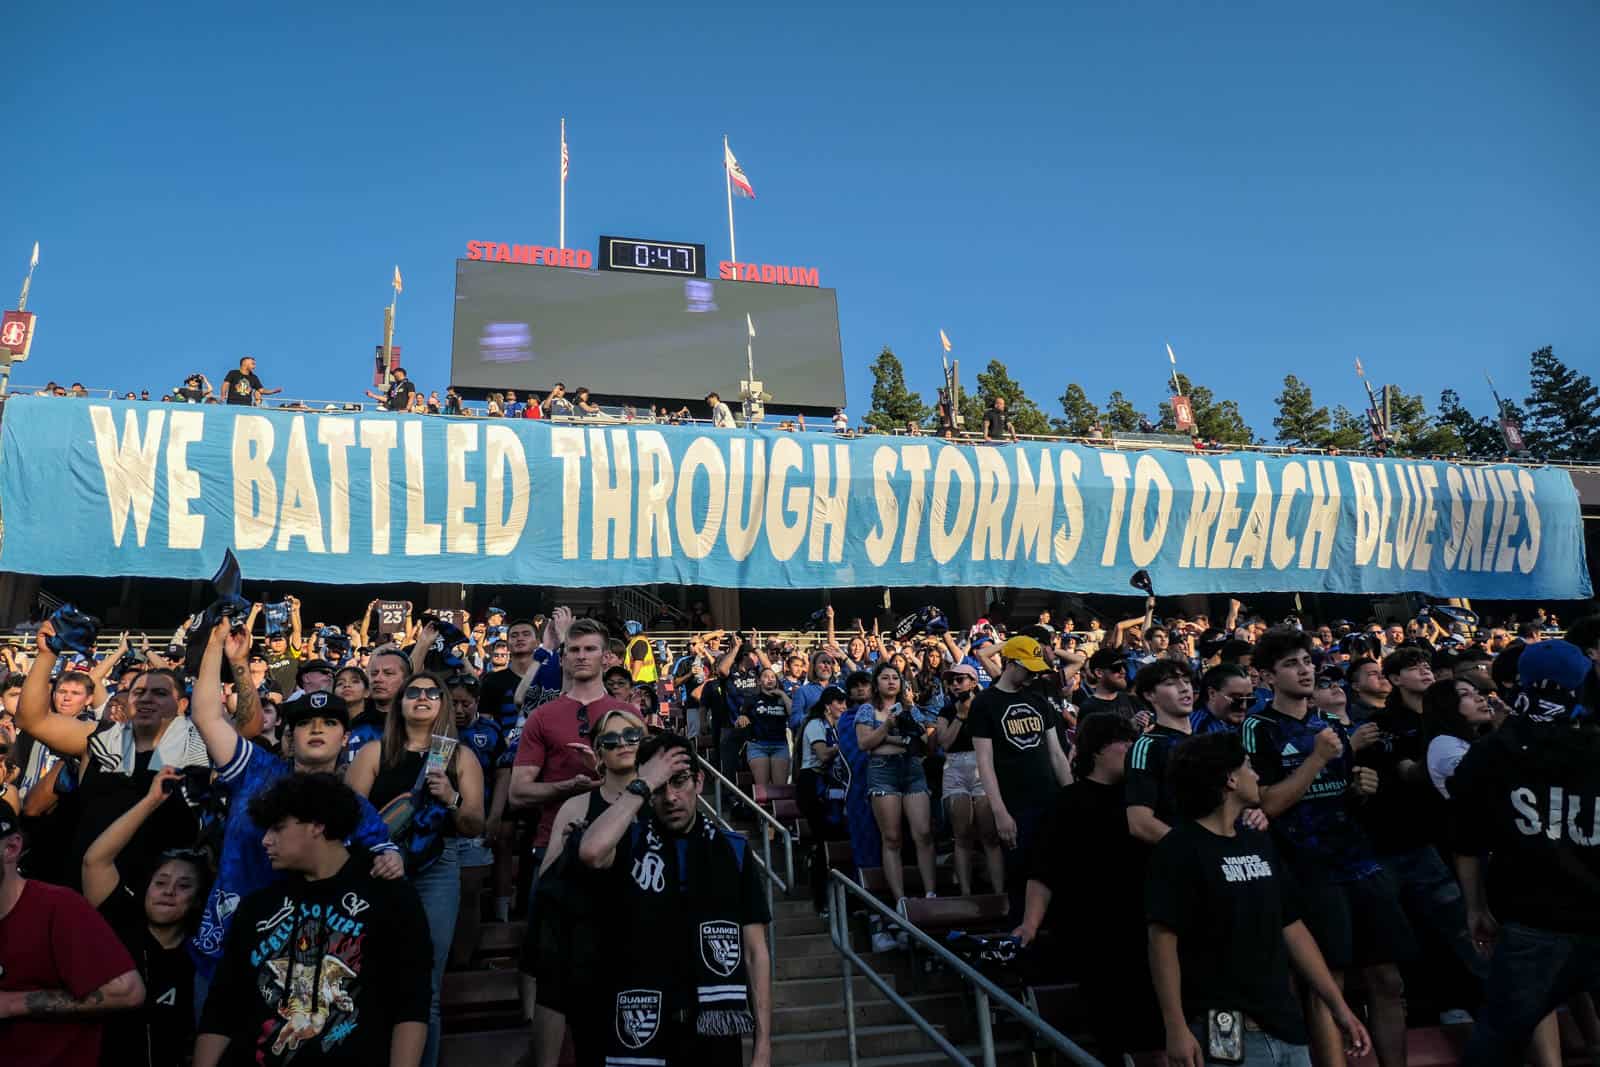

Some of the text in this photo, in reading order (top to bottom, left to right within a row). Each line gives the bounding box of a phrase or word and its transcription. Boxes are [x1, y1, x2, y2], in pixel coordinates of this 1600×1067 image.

[466, 240, 592, 269] STANFORD
[635, 245, 689, 269] 0:47
[720, 261, 819, 287] STADIUM
[89, 405, 1541, 575] WE BATTLED THROUGH STORMS TO REACH BLUE SKIES
[383, 611, 402, 624] 23
[1007, 716, 1041, 735] UNITED
[1223, 854, 1261, 865] VAMOS
[1221, 861, 1272, 882] SAN JOSE
[703, 926, 738, 935] QUAKES
[619, 995, 659, 1005] QUAKES
